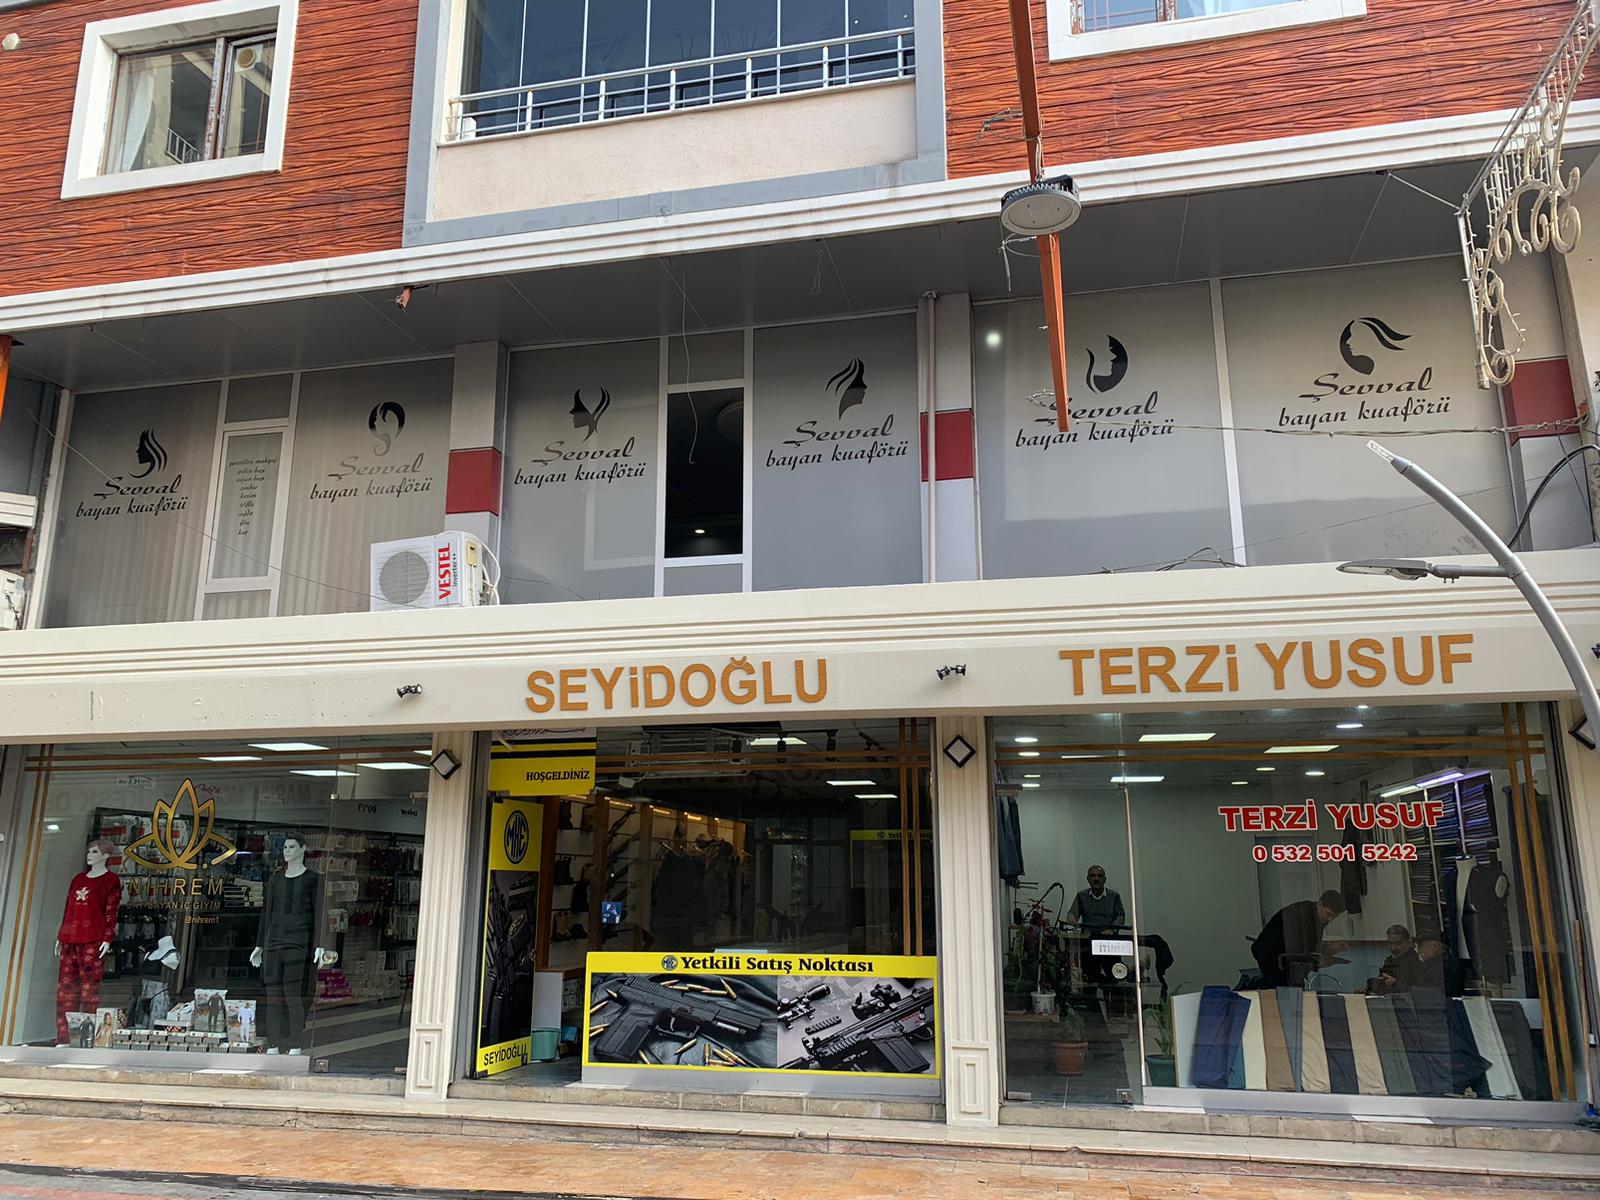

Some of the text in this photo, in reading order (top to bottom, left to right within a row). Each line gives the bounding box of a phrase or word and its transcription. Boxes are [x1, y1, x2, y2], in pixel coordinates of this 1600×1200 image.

[1298, 366, 1433, 403] Şevval
[1278, 396, 1451, 430] bayan kuaförü
[782, 413, 894, 449] Şevval
[1015, 418, 1174, 451] bayan kuaförü
[327, 452, 424, 481] Şevval
[531, 436, 635, 467] Şevval
[766, 440, 909, 471] bayan kuaförü
[93, 473, 183, 499] Şevval
[310, 477, 433, 503] bayan kuaförü
[514, 462, 646, 488] bayan kuaförü
[76, 496, 189, 520] bayan kuaförü
[438, 542, 451, 600] VESTEL
[1254, 633, 1475, 691] YUSUF
[526, 767, 590, 783] HOŞGELDİNİZ
[1218, 798, 1444, 831] TERZİ YUSUF
[1253, 843, 1418, 862] 0 532 501 5242
[681, 955, 741, 970] Yetkili
[746, 956, 793, 974] Satış
[799, 957, 874, 972] Noktası
